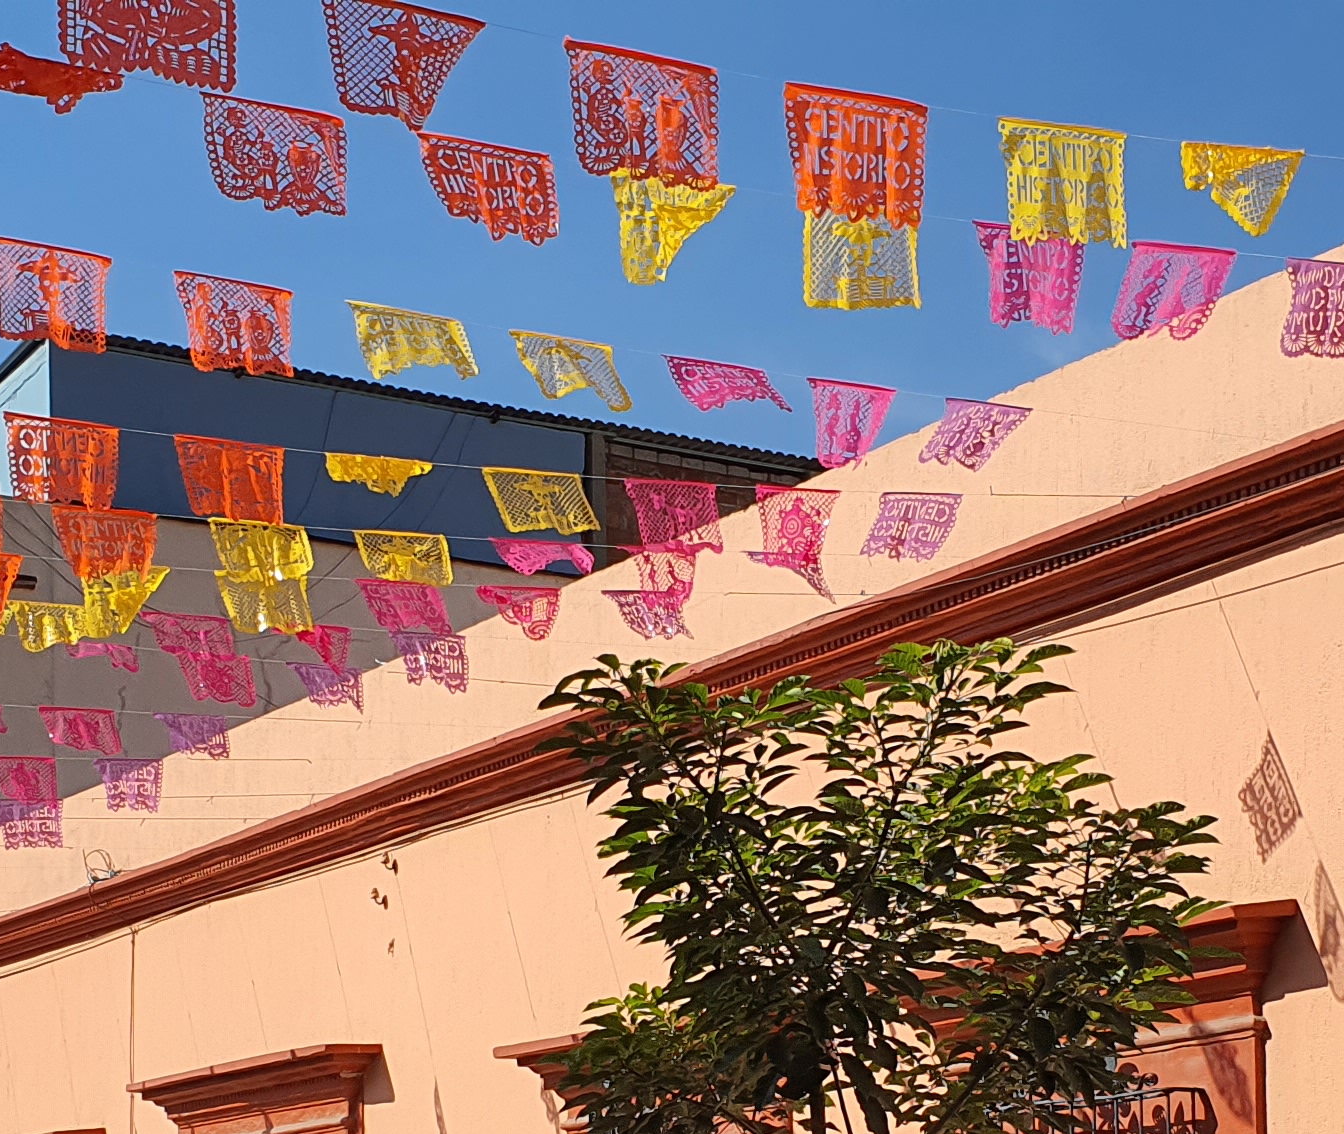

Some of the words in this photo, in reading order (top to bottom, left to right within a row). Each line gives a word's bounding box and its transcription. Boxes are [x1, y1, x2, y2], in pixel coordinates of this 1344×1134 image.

[805, 108, 910, 152] CENTRO
[437, 149, 538, 188] CENTRO
[1016, 139, 1113, 174] CENTRO
